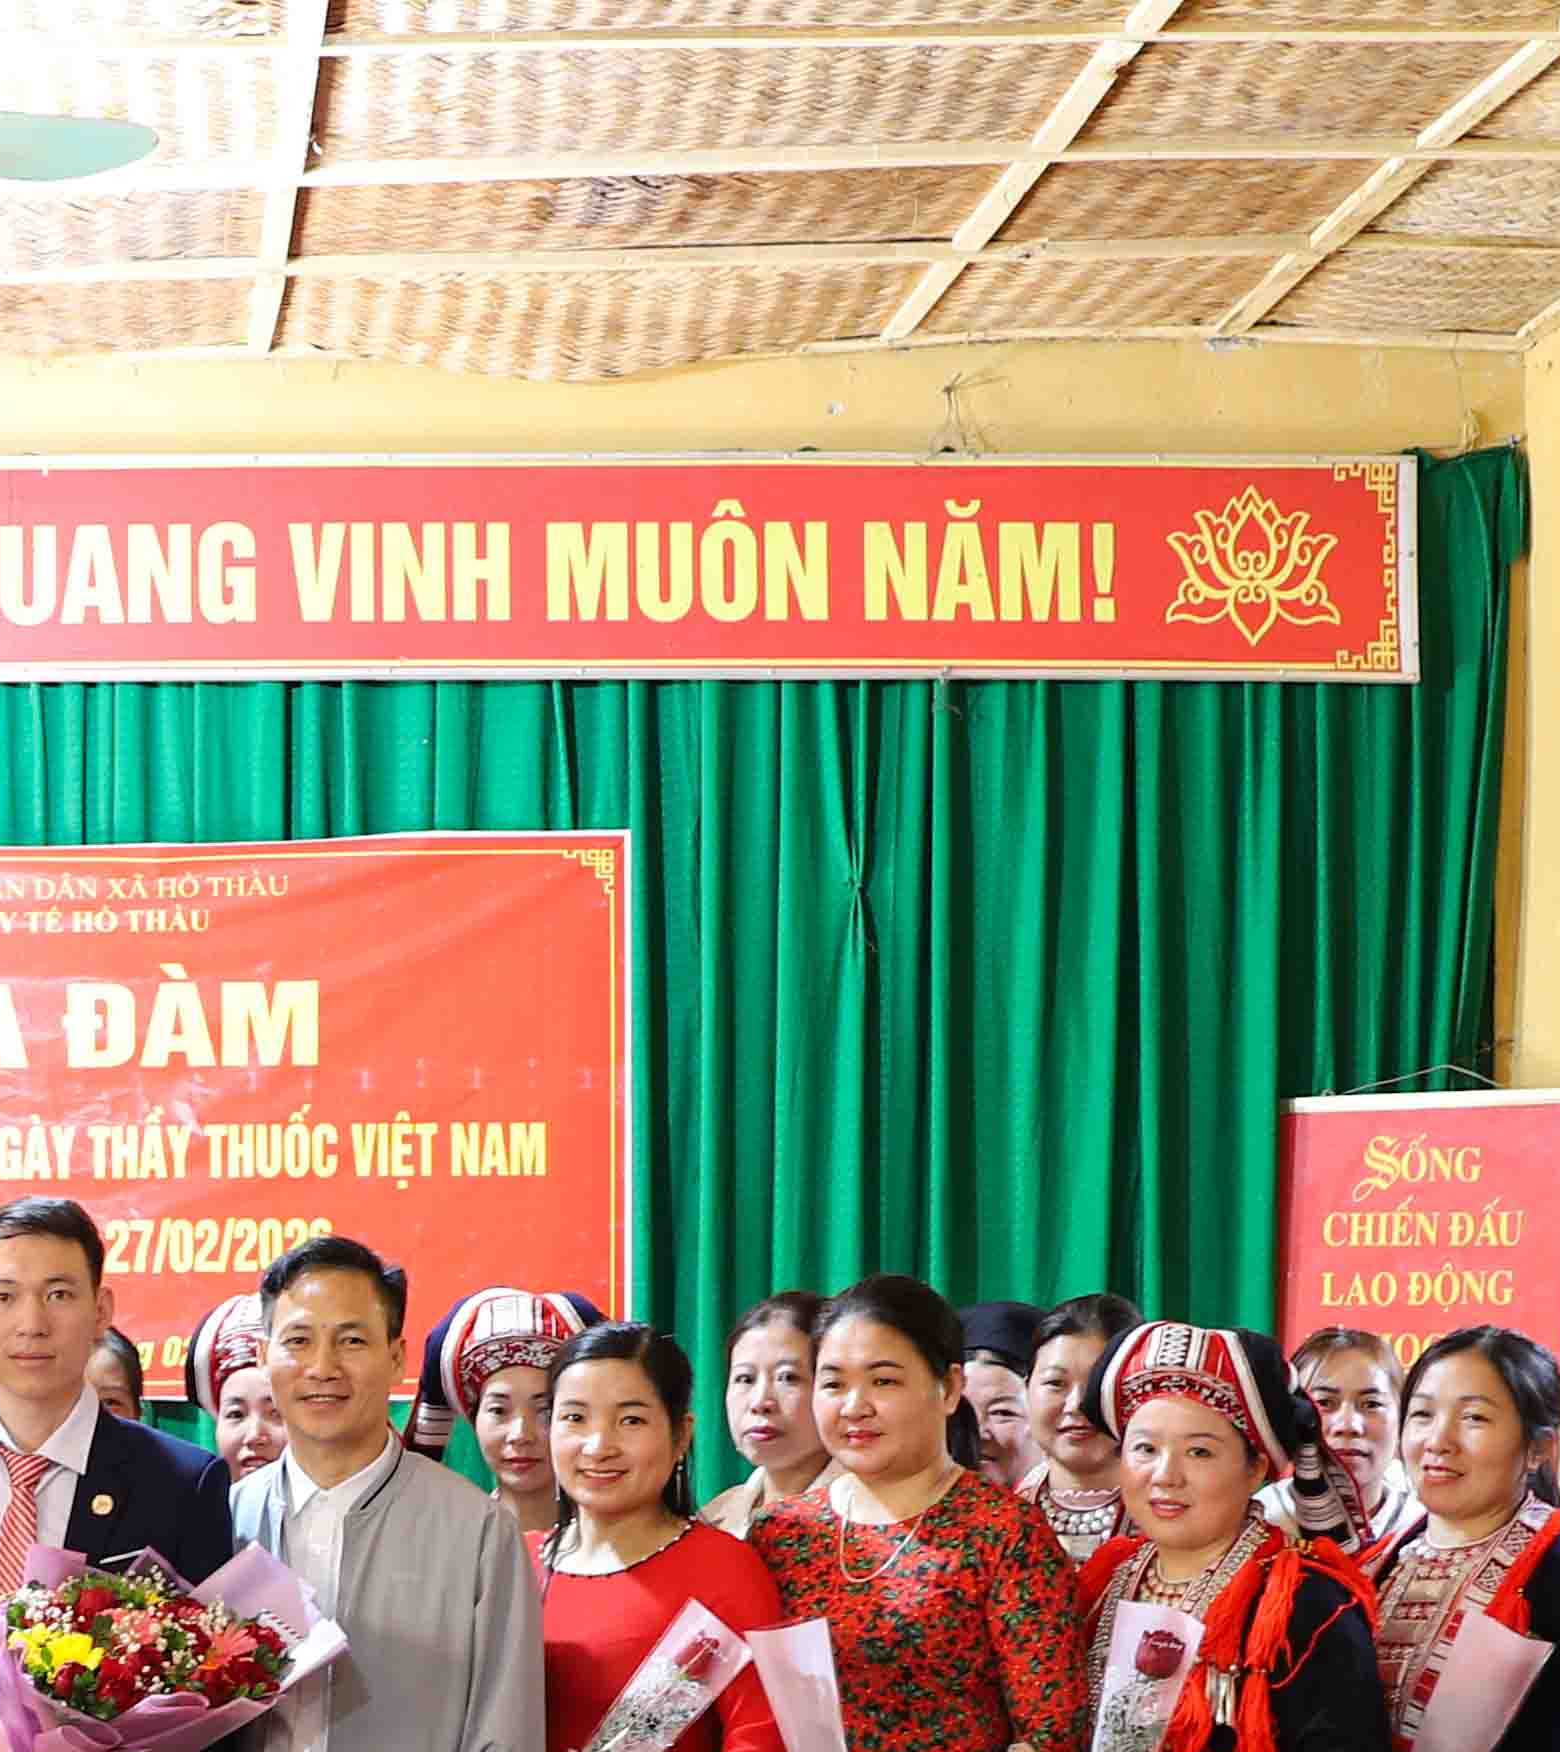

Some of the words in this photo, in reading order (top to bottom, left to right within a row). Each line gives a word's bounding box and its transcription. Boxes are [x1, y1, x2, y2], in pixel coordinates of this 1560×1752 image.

[287, 522, 511, 621] VINH
[545, 499, 828, 622] MUÔN
[864, 499, 1116, 623] NĂM!
[62, 963, 320, 1068] ĐÀM
[87, 1104, 192, 1180] THẦY
[204, 1103, 339, 1179] THUỐC
[350, 1110, 438, 1190] VIỆT
[450, 1121, 549, 1177] NAM
[1352, 1134, 1482, 1202] SỐNG
[1323, 1195, 1439, 1248] CHIẾN
[1449, 1198, 1525, 1247] ĐẤU
[1320, 1271, 1398, 1306] LAO
[1408, 1261, 1513, 1312] ĐỘNG
